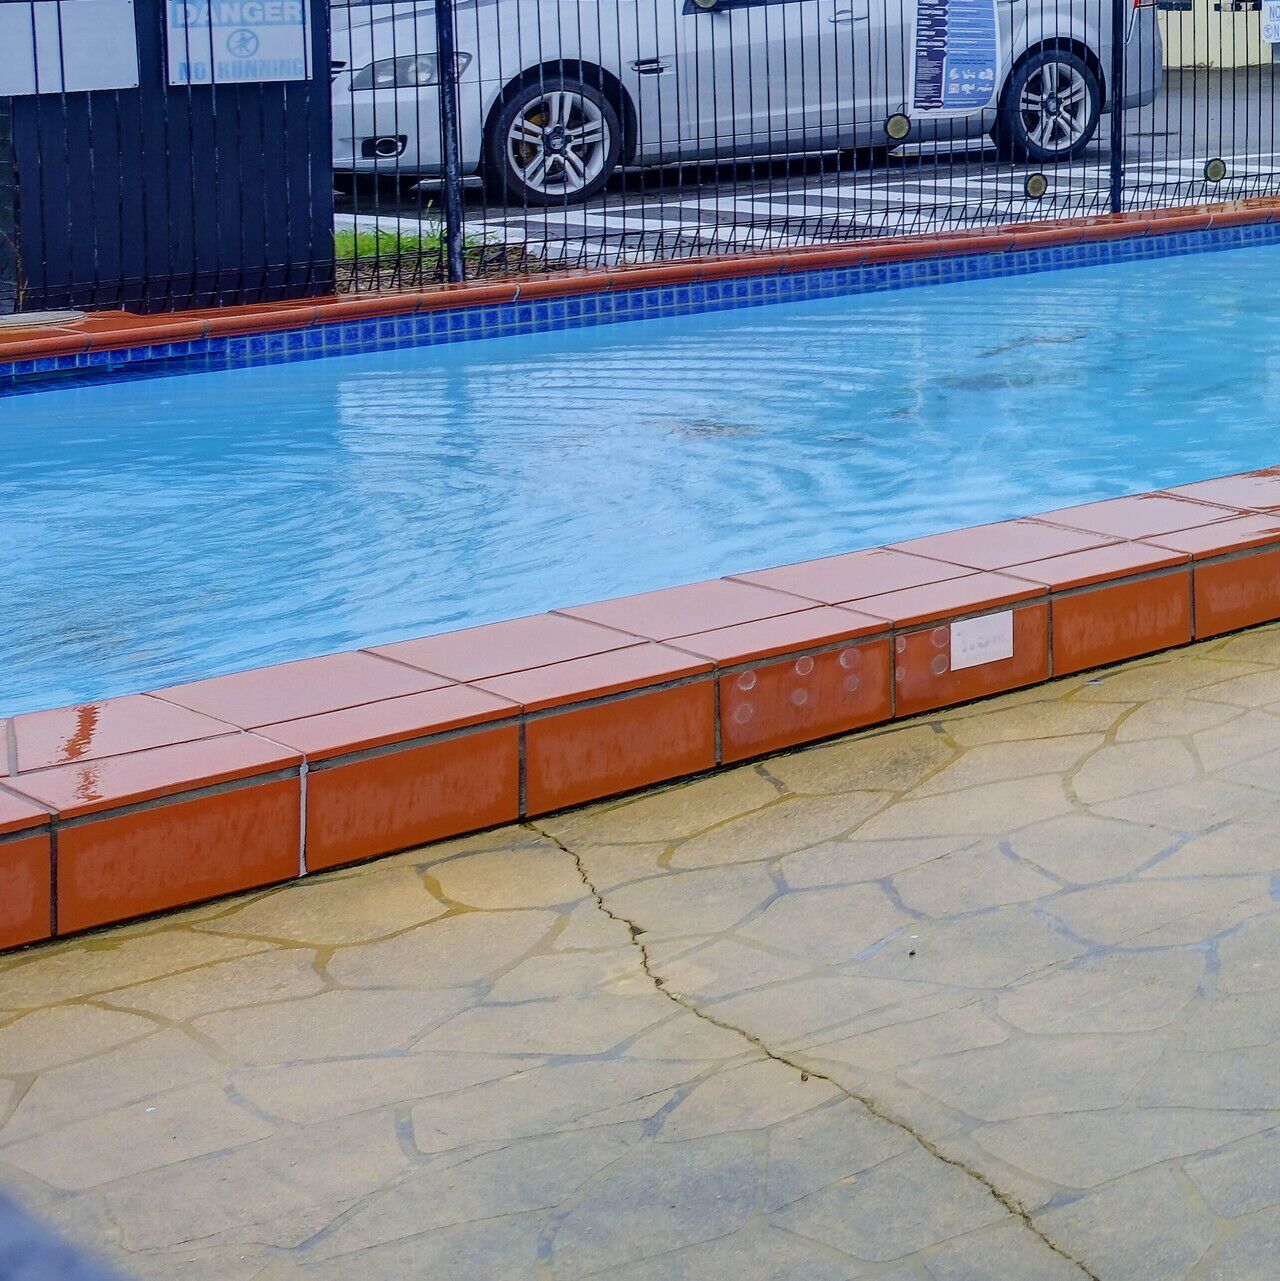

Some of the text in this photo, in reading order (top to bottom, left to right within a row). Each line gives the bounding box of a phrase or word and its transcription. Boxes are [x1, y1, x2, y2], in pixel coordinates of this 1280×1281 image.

[176, 1, 302, 24] DANGER
[179, 58, 304, 81] NO RUNNING
